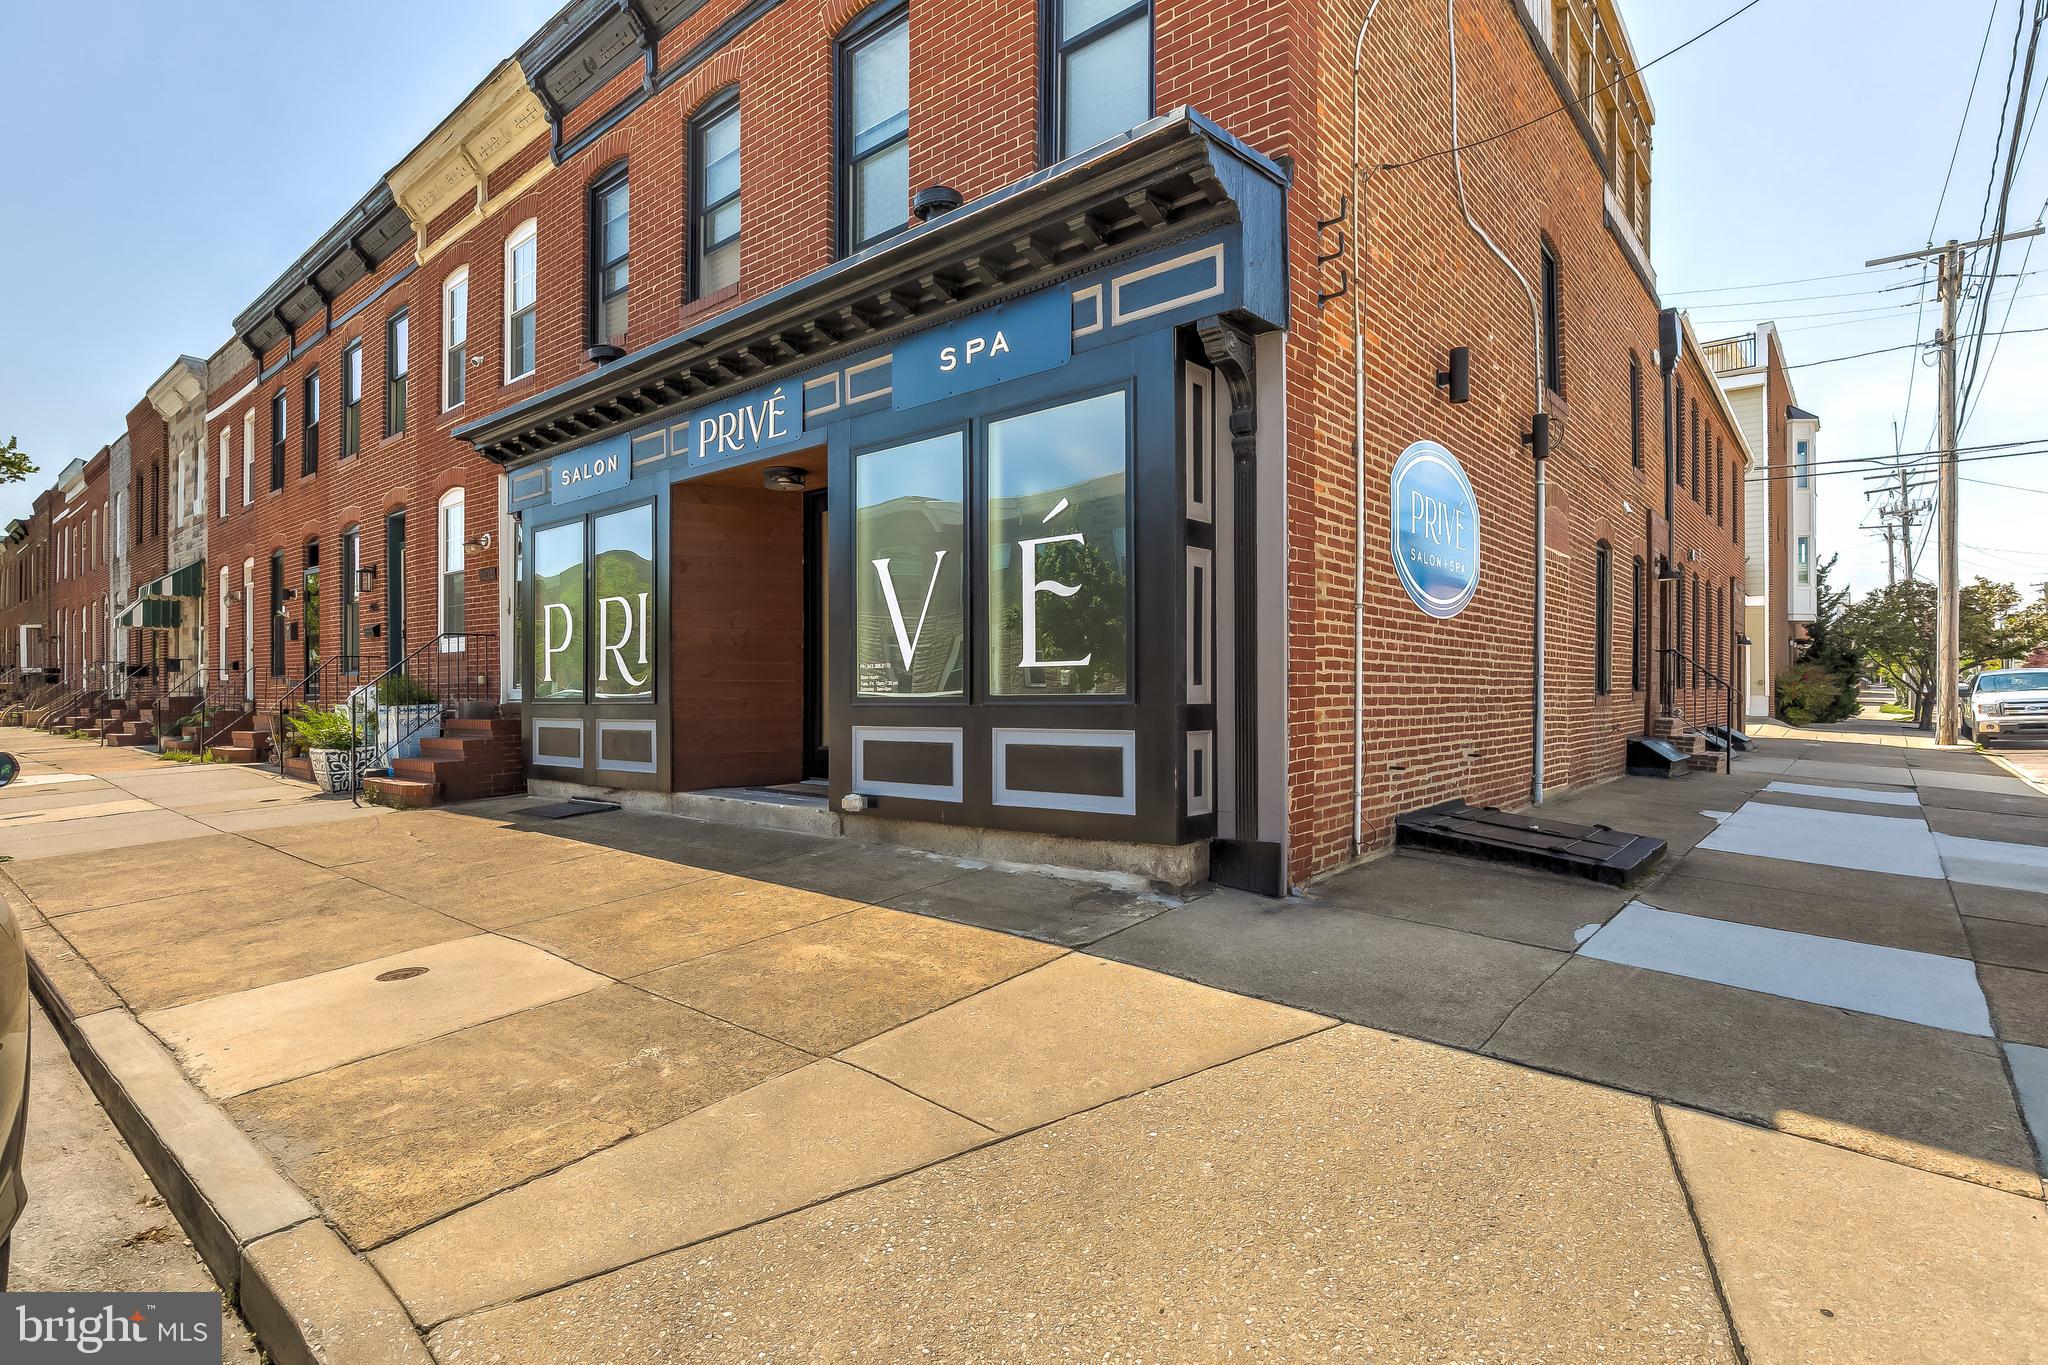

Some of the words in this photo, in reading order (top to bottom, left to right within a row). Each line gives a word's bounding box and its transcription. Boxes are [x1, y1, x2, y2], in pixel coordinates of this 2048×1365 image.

[939, 330, 1011, 372] SPA
[698, 388, 788, 458] PRIVÉ
[560, 453, 619, 487] SALON
[1411, 489, 1467, 551] PRIVÉ
